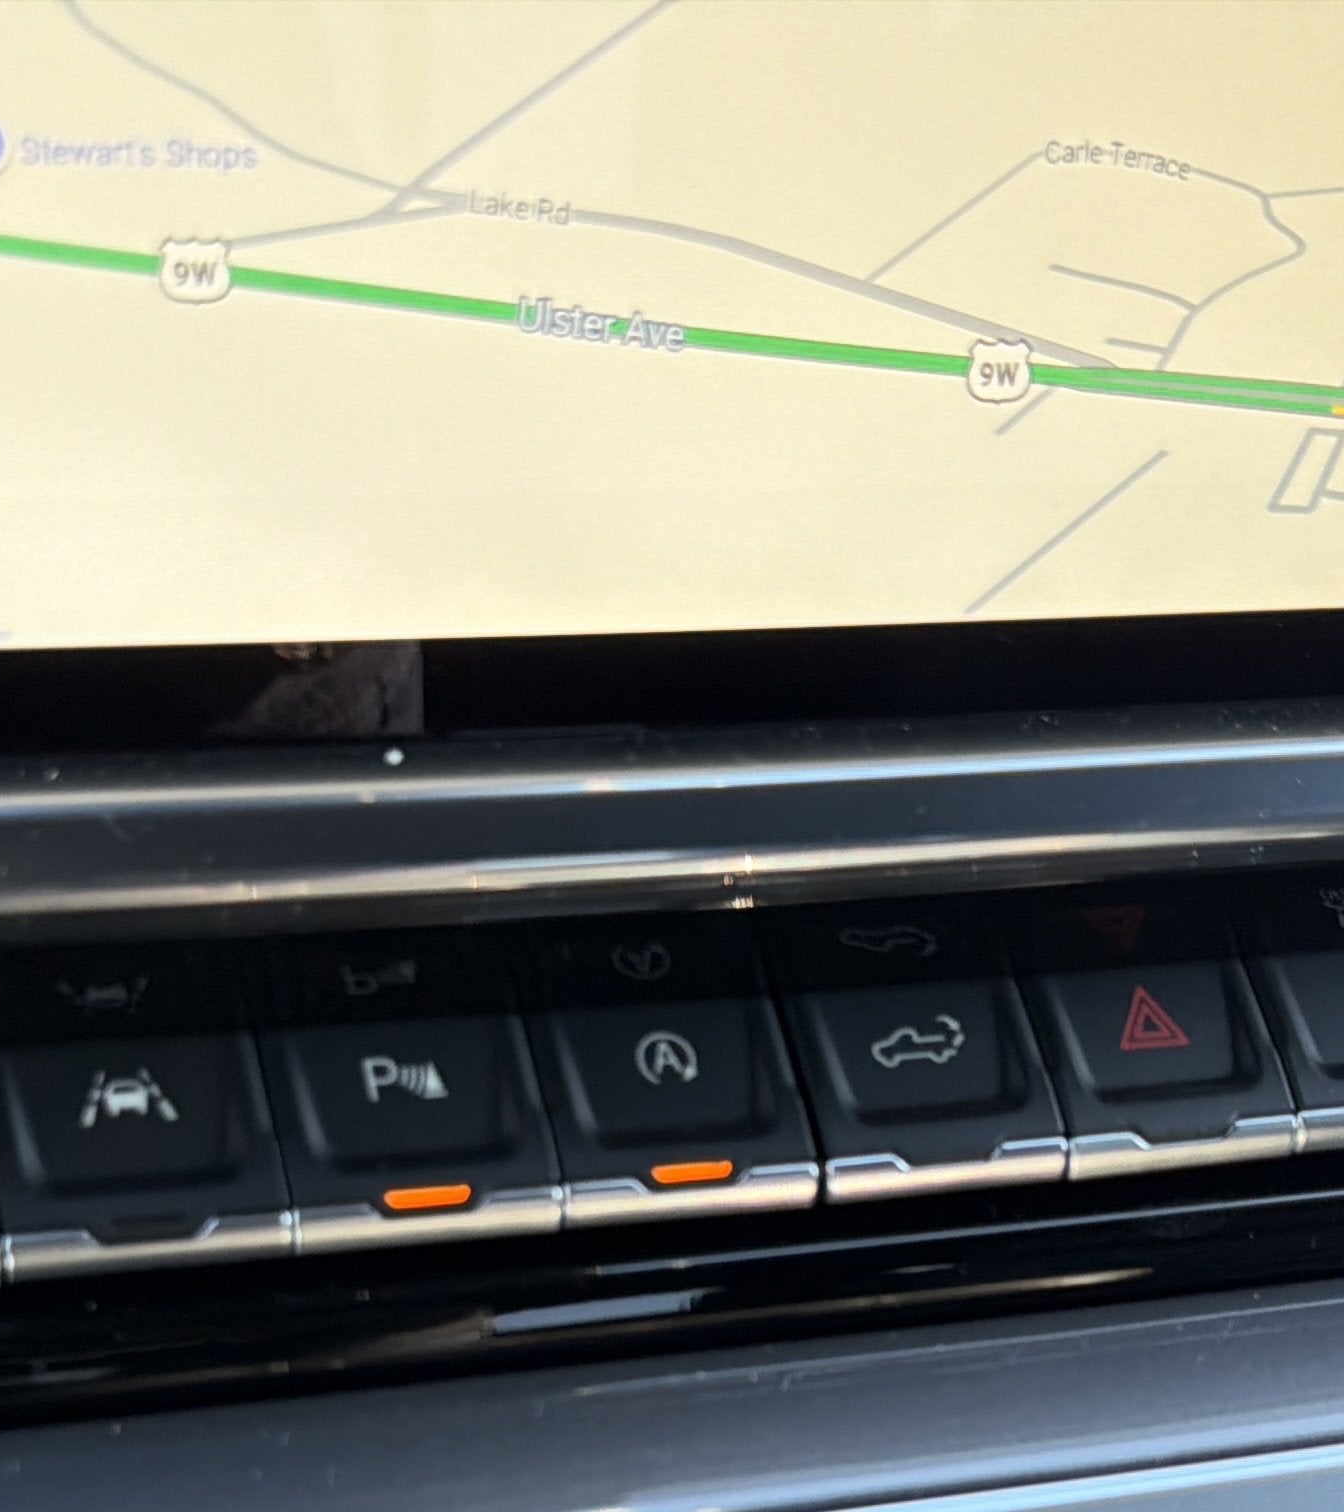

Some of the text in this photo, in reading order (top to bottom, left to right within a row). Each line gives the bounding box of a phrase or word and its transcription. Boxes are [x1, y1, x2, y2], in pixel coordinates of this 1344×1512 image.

[21, 137, 258, 171] Stewart's Shops
[1044, 140, 1192, 180] Carle Terrace
[469, 189, 571, 225] Lake Rd
[173, 261, 218, 287] 9W
[519, 295, 685, 351] Ulster Ave
[979, 361, 1020, 387] 9W
[361, 1055, 399, 1103] P
